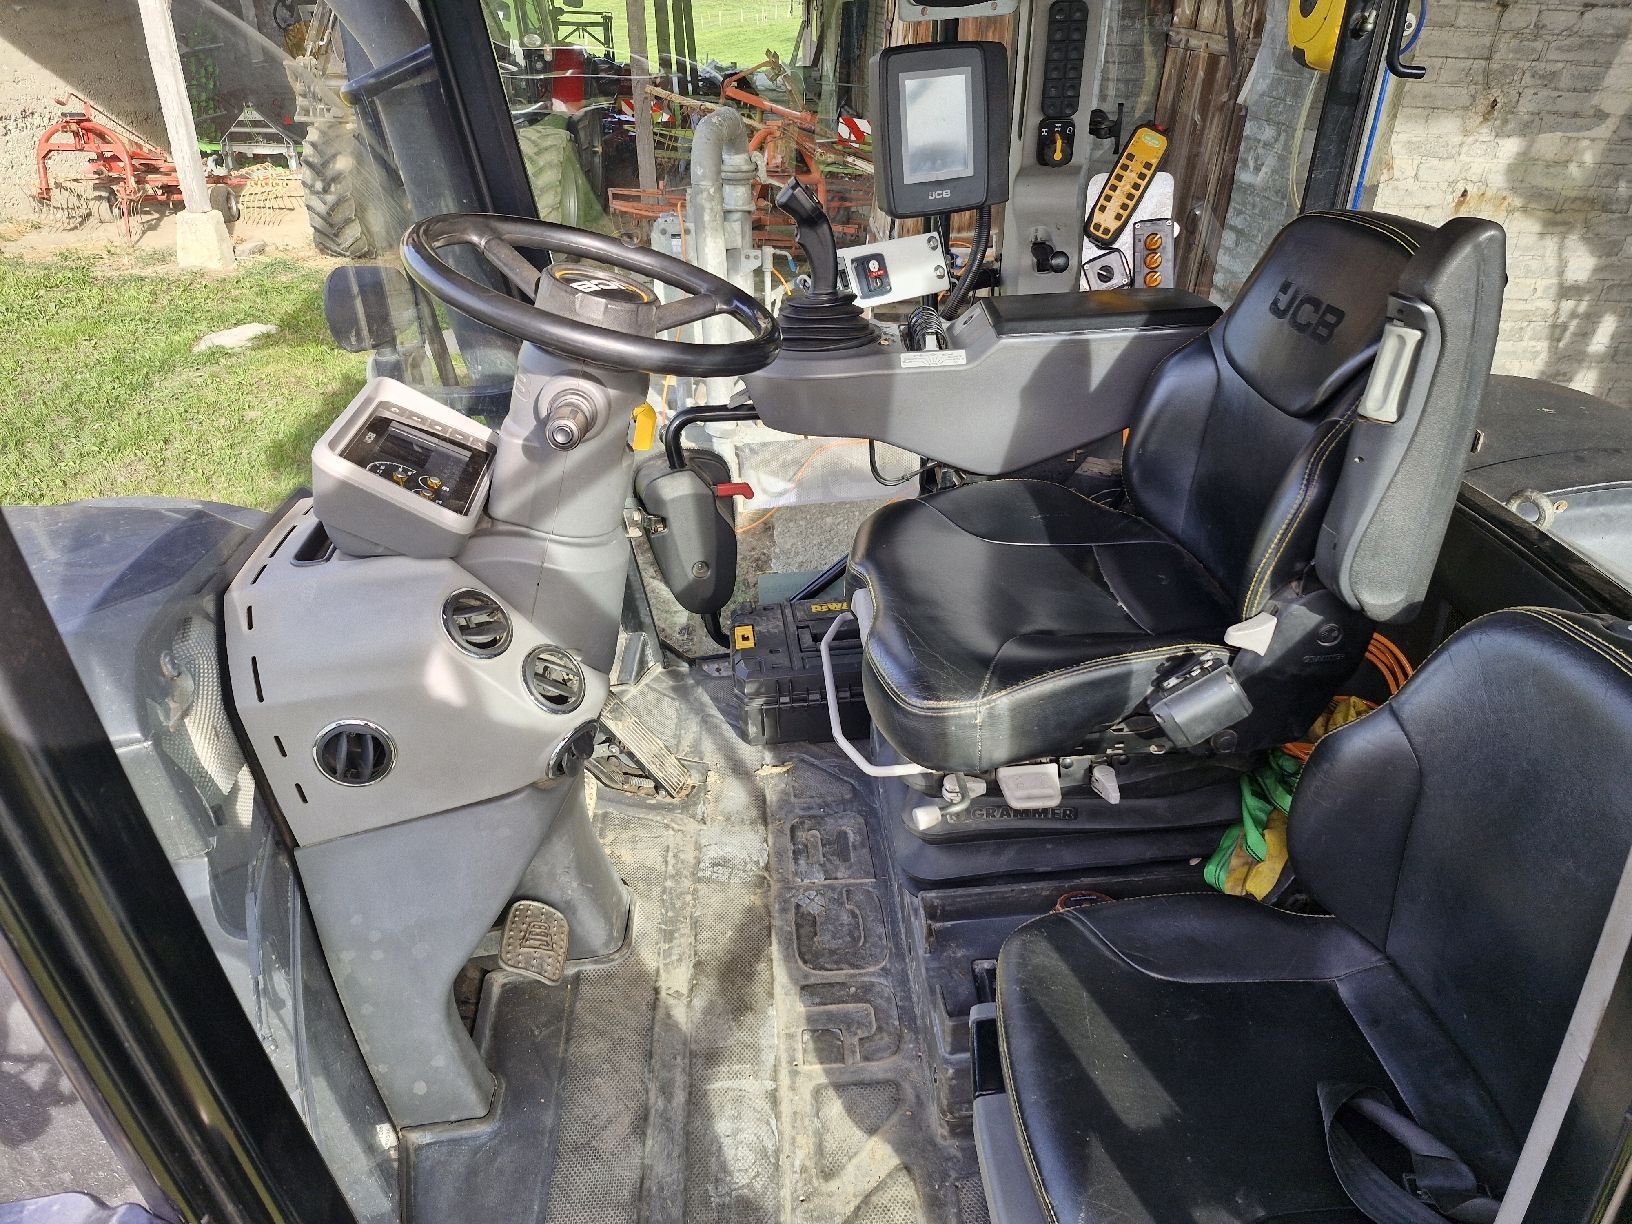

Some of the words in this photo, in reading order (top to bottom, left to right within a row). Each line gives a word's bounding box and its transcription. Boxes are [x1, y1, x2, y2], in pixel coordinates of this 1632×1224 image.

[928, 189, 951, 200] JCB
[1269, 279, 1346, 346] JCB
[970, 806, 1079, 820] GRAMMER
[519, 920, 555, 953] JCB
